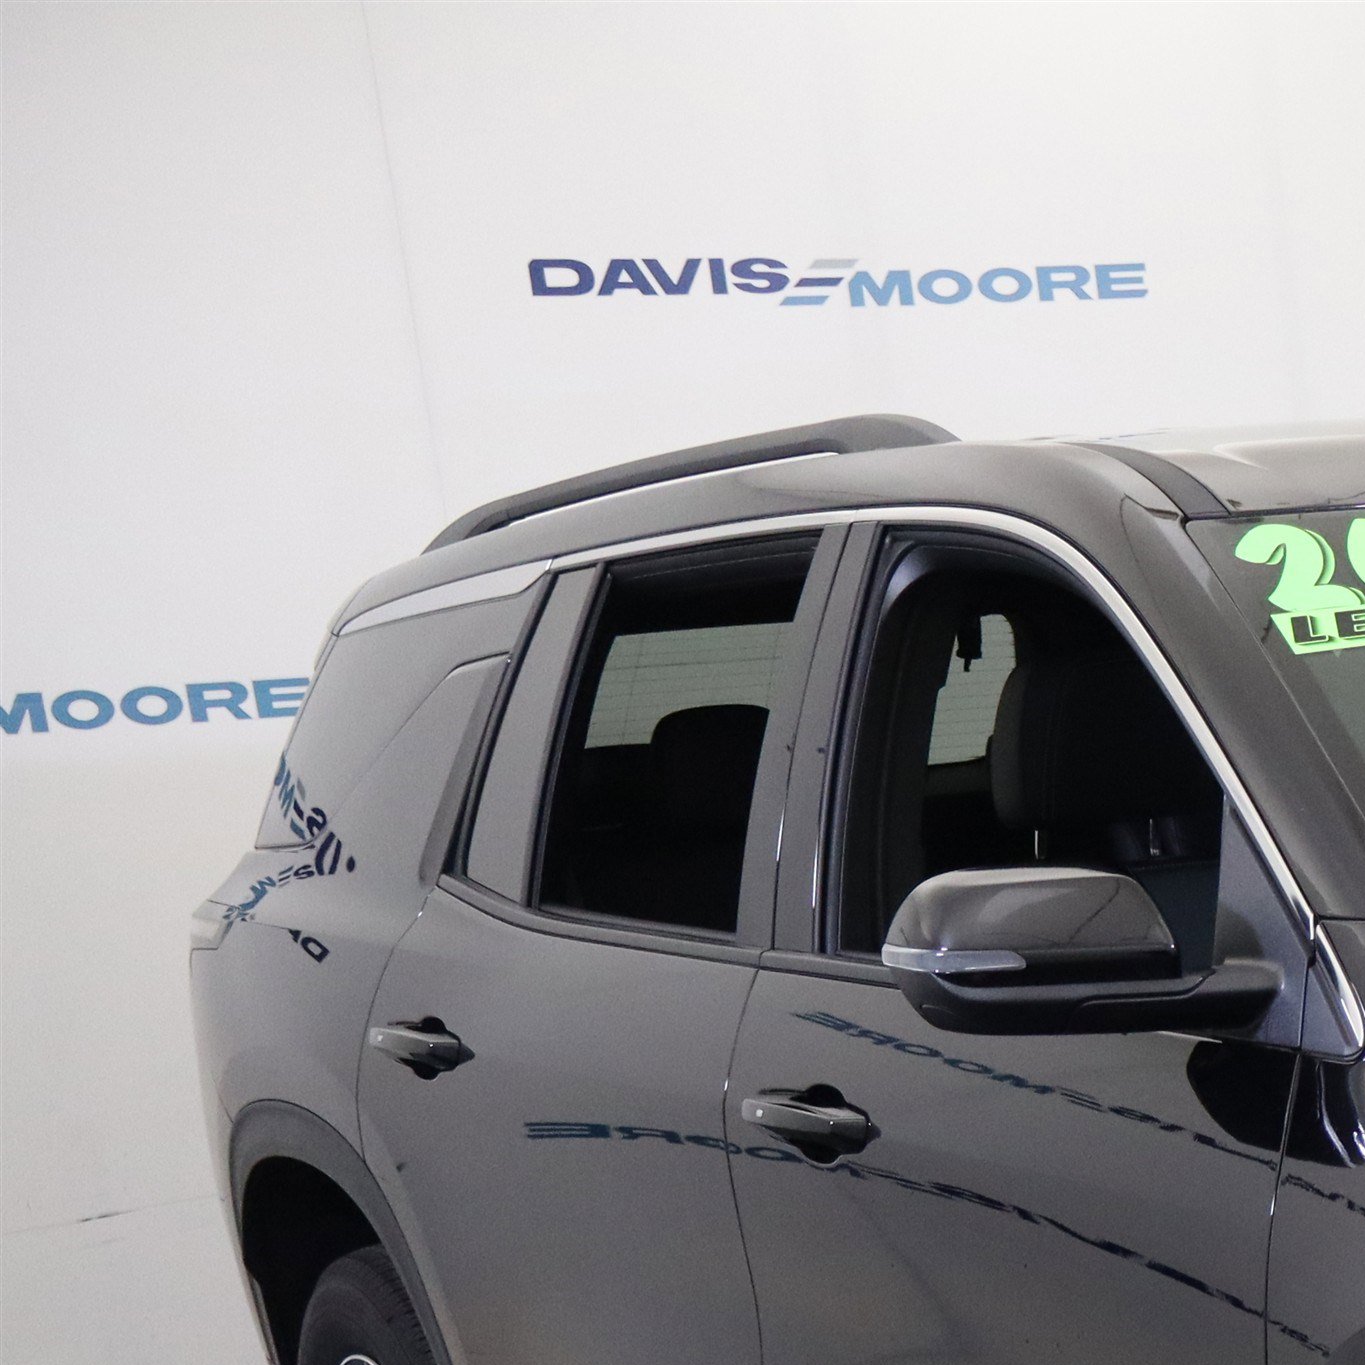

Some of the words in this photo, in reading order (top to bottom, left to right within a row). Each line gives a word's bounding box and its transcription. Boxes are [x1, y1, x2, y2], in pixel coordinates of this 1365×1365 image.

[527, 256, 791, 298] DAVIS
[848, 262, 1149, 308] MOORE
[0, 677, 311, 735] MOORE
